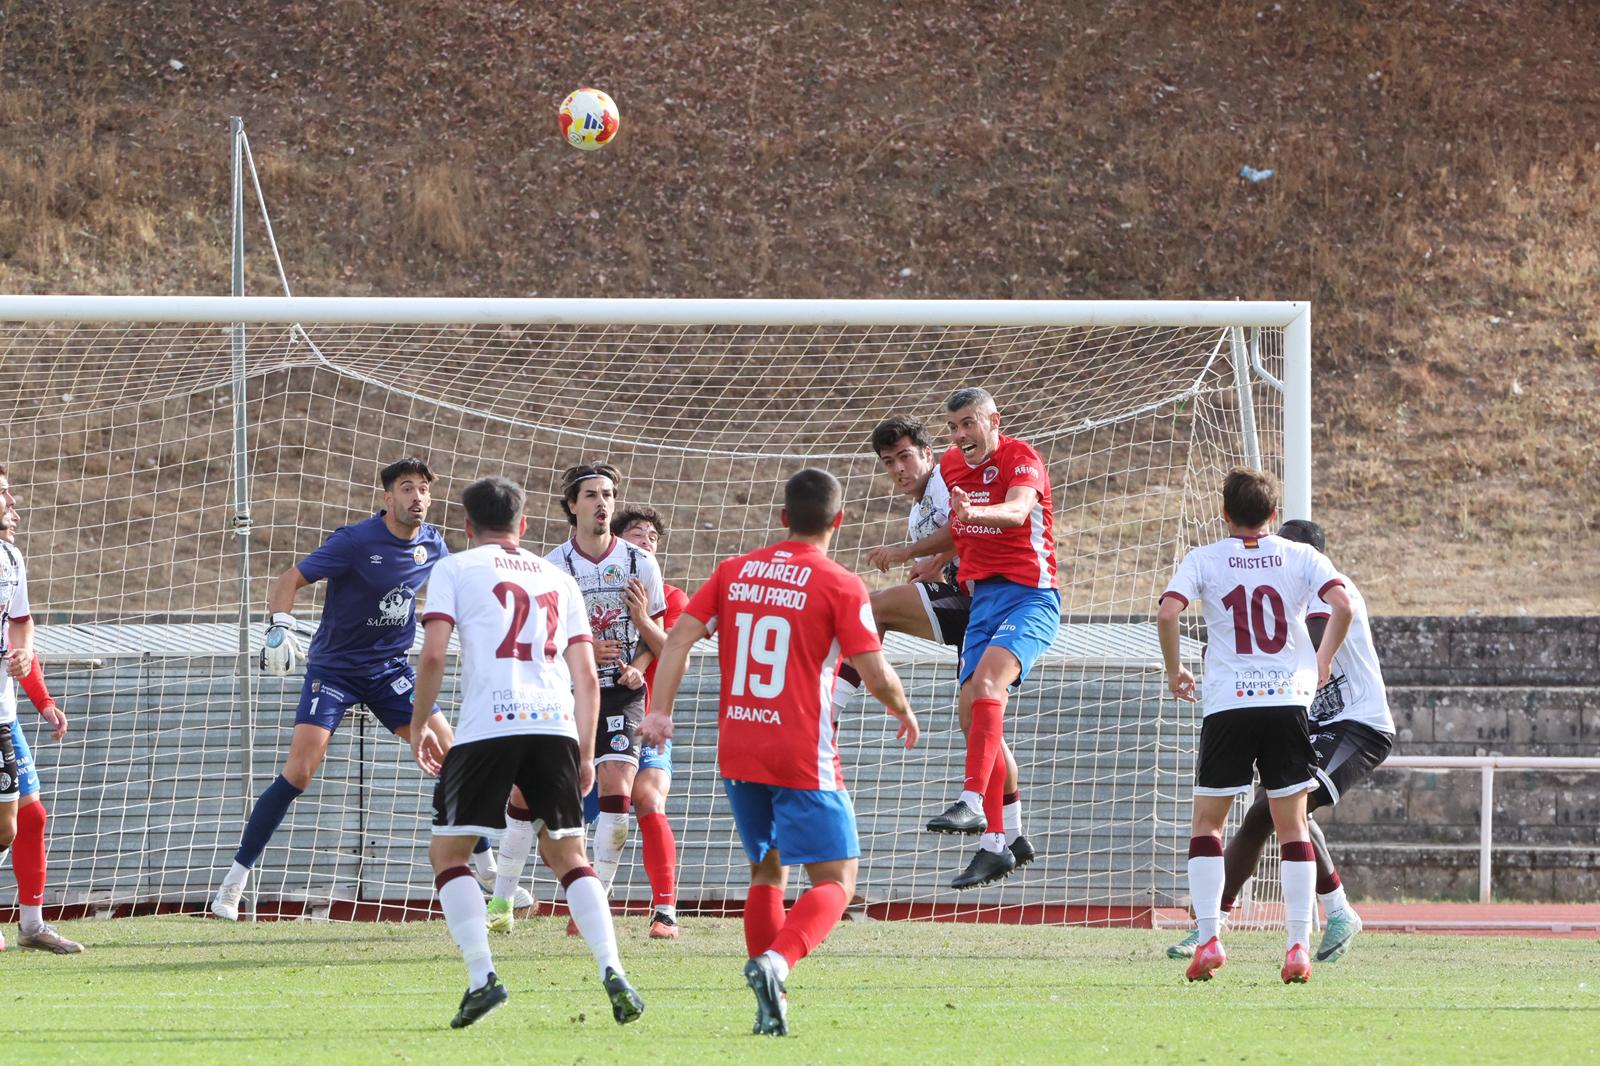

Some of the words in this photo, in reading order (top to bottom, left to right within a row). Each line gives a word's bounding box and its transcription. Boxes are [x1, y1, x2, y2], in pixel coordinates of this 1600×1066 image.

[966, 525, 1003, 535] COSAGA
[494, 557, 542, 573] AIMAR
[738, 560, 812, 587] POVARELO
[1228, 555, 1283, 569] CRISTETO
[728, 582, 765, 604] SAMU
[764, 586, 807, 611] PARDO
[492, 581, 559, 664] 21
[1221, 584, 1288, 654] 10
[731, 612, 791, 699] 19
[309, 697, 320, 715] 1
[727, 705, 782, 724] ABANCA
